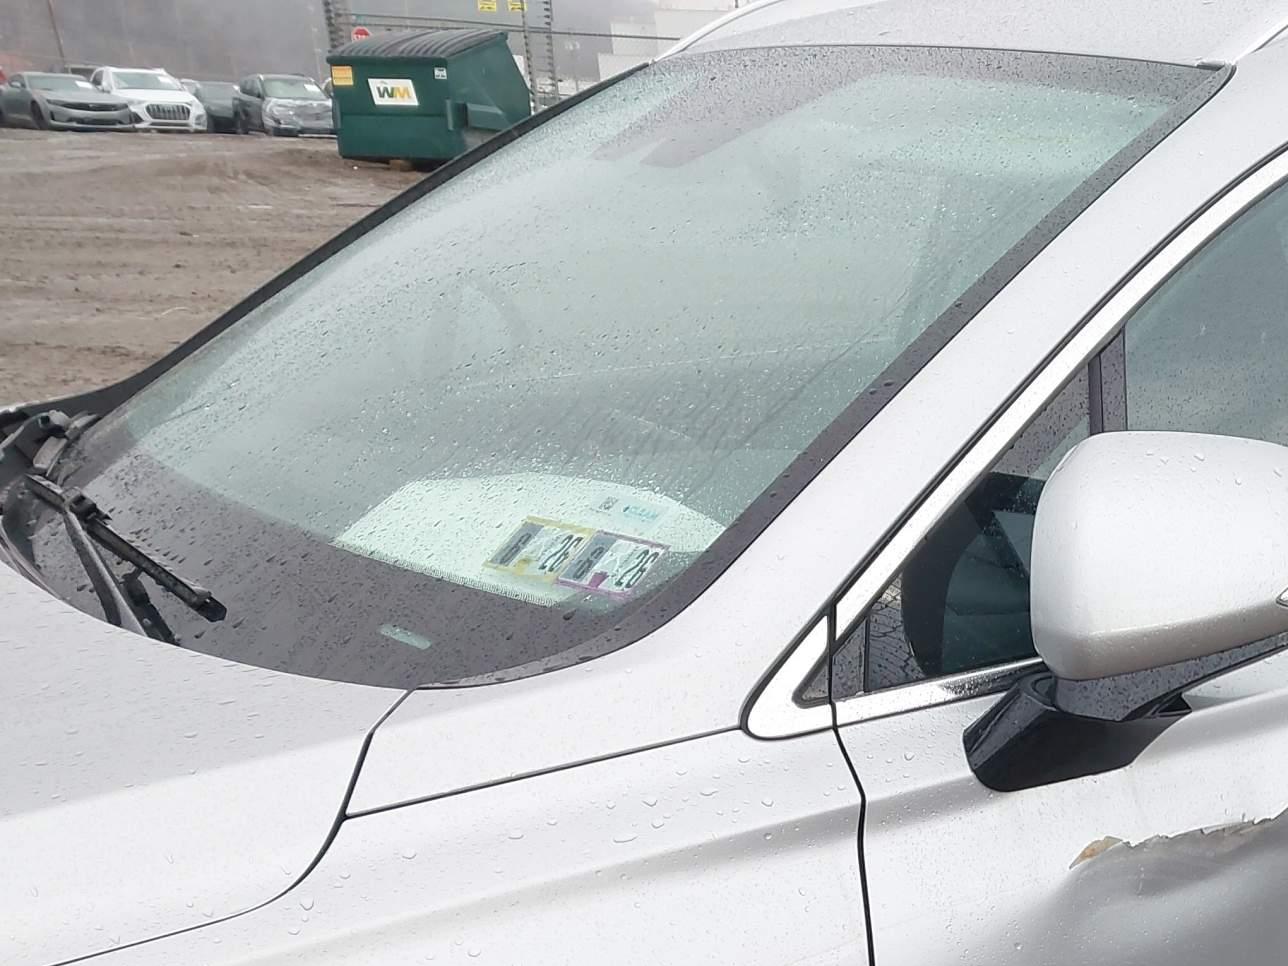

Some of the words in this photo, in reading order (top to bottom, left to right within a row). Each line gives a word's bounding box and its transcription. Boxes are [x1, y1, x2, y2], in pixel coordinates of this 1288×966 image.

[376, 86, 411, 98] WM
[538, 534, 583, 572] 26
[615, 549, 660, 588] 26
